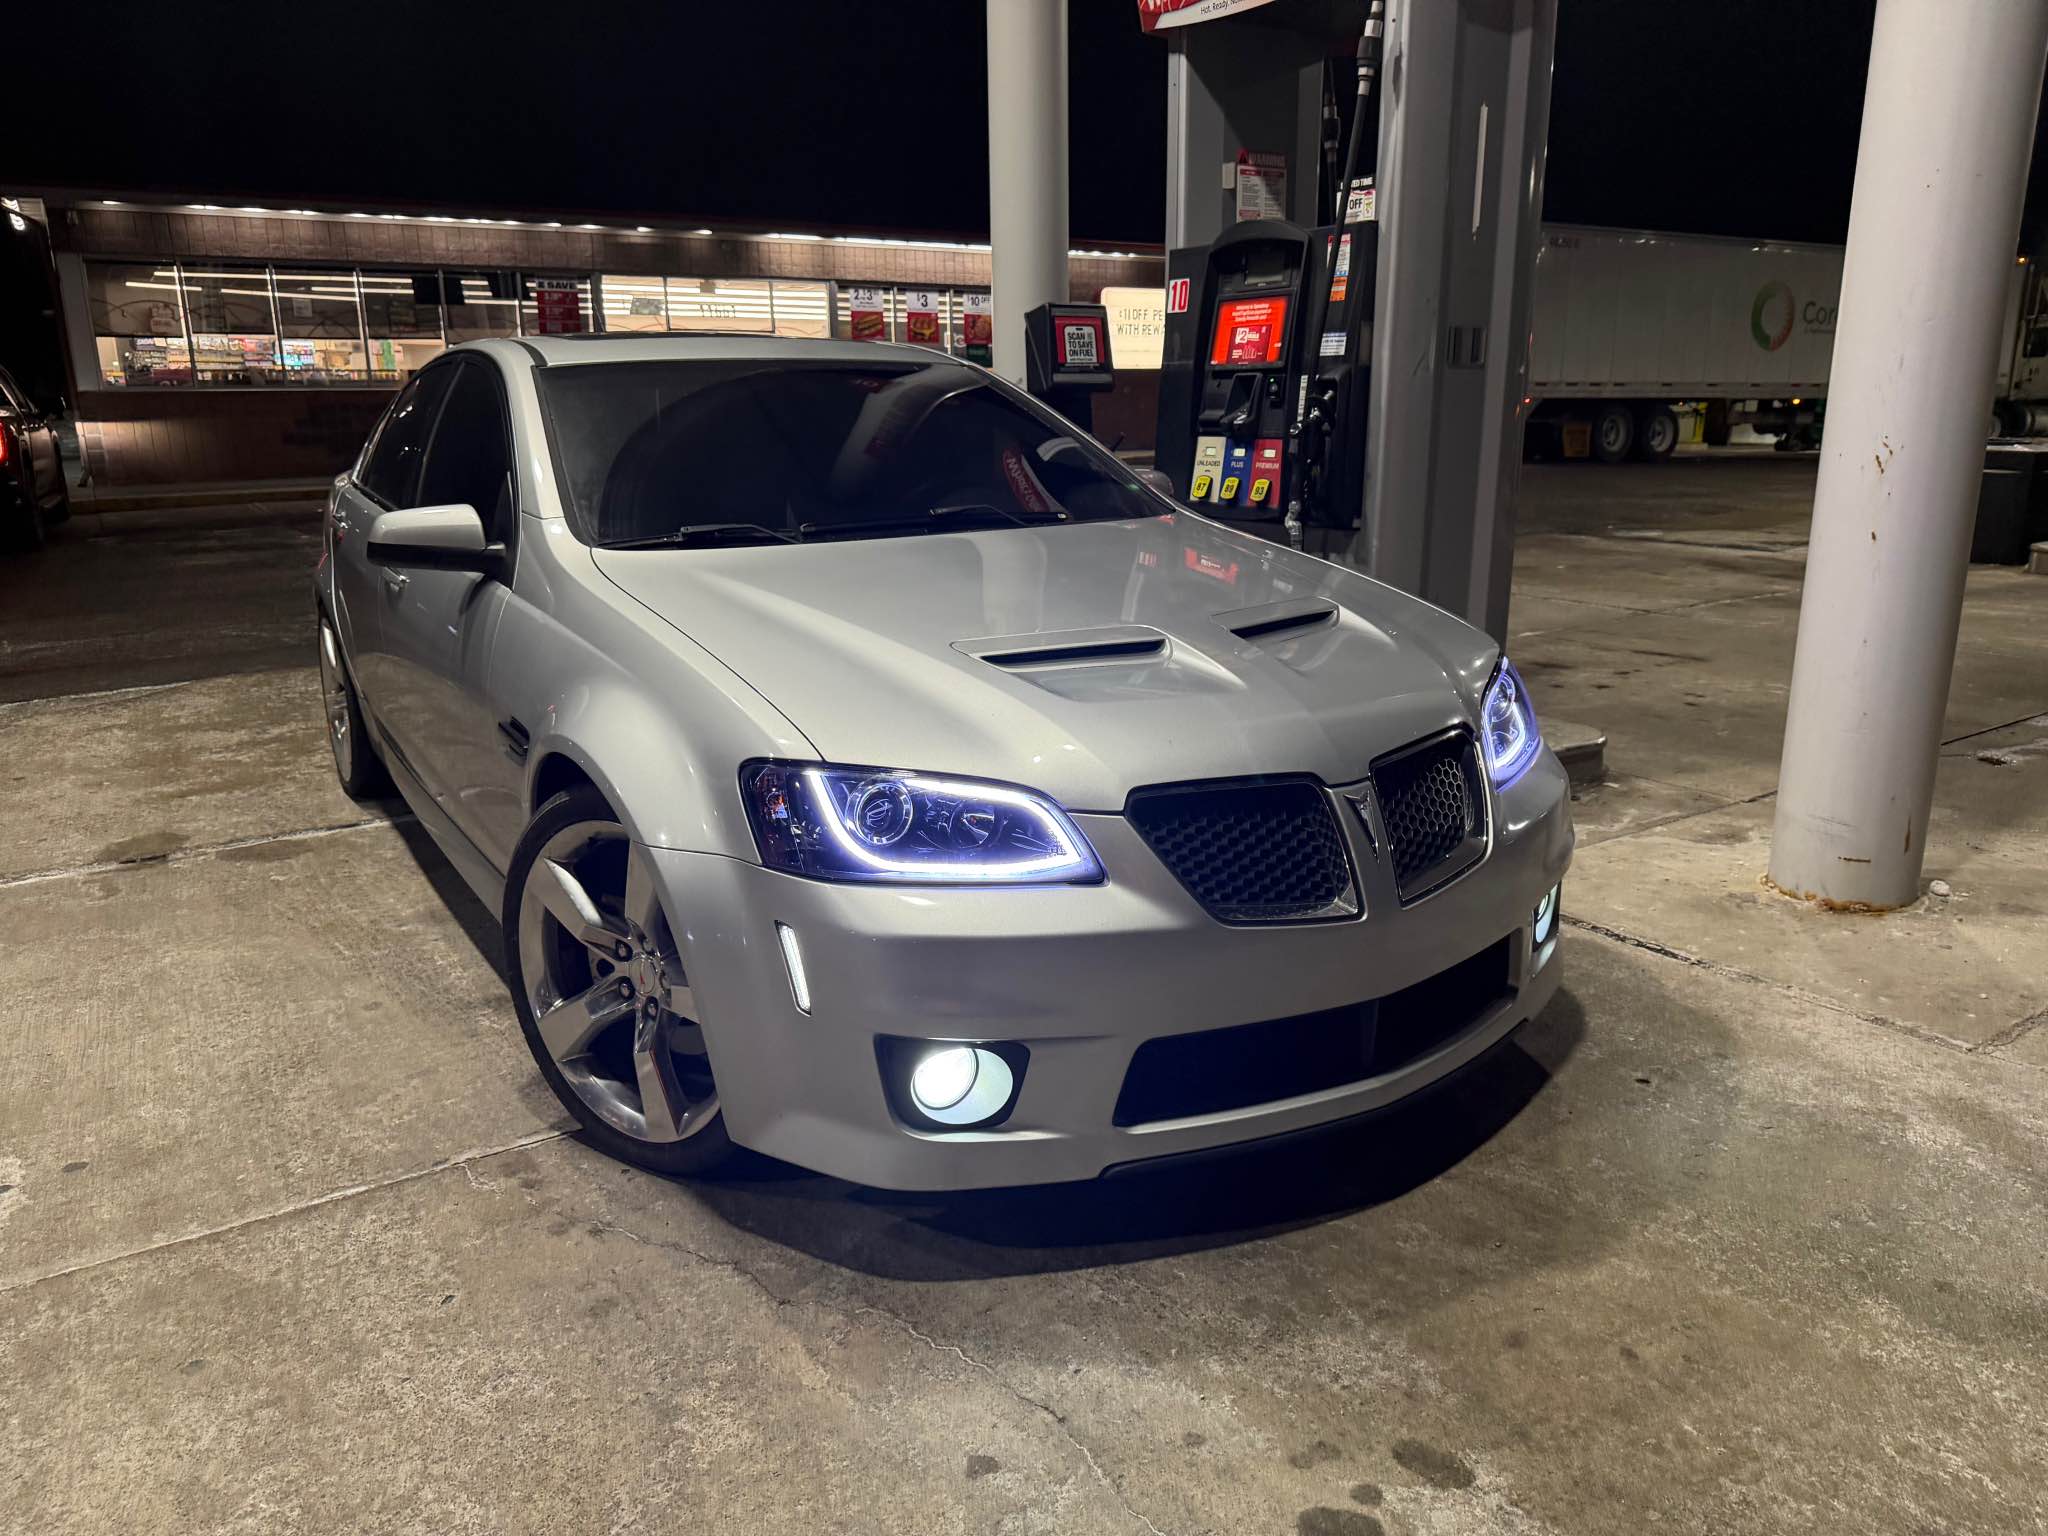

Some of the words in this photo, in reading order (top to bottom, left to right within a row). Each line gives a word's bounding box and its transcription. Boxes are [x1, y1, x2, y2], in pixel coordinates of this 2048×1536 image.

[1349, 198, 1363, 210] OFF
[547, 281, 576, 289] SAVE
[853, 288, 860, 300] 2
[1171, 280, 1190, 313] 10
[916, 293, 929, 308] $3
[1132, 309, 1148, 321] OFF
[1117, 323, 1139, 336] WITH
[1067, 332, 1086, 341] SCAN
[1068, 341, 1077, 349] TO
[1077, 341, 1094, 349] SAVE
[1069, 349, 1079, 357] ON
[1079, 349, 1094, 357] FUEL
[1230, 461, 1244, 469] PLUS
[1196, 482, 1206, 492] 87
[1224, 484, 1235, 493] 89
[1255, 486, 1265, 496] 93
